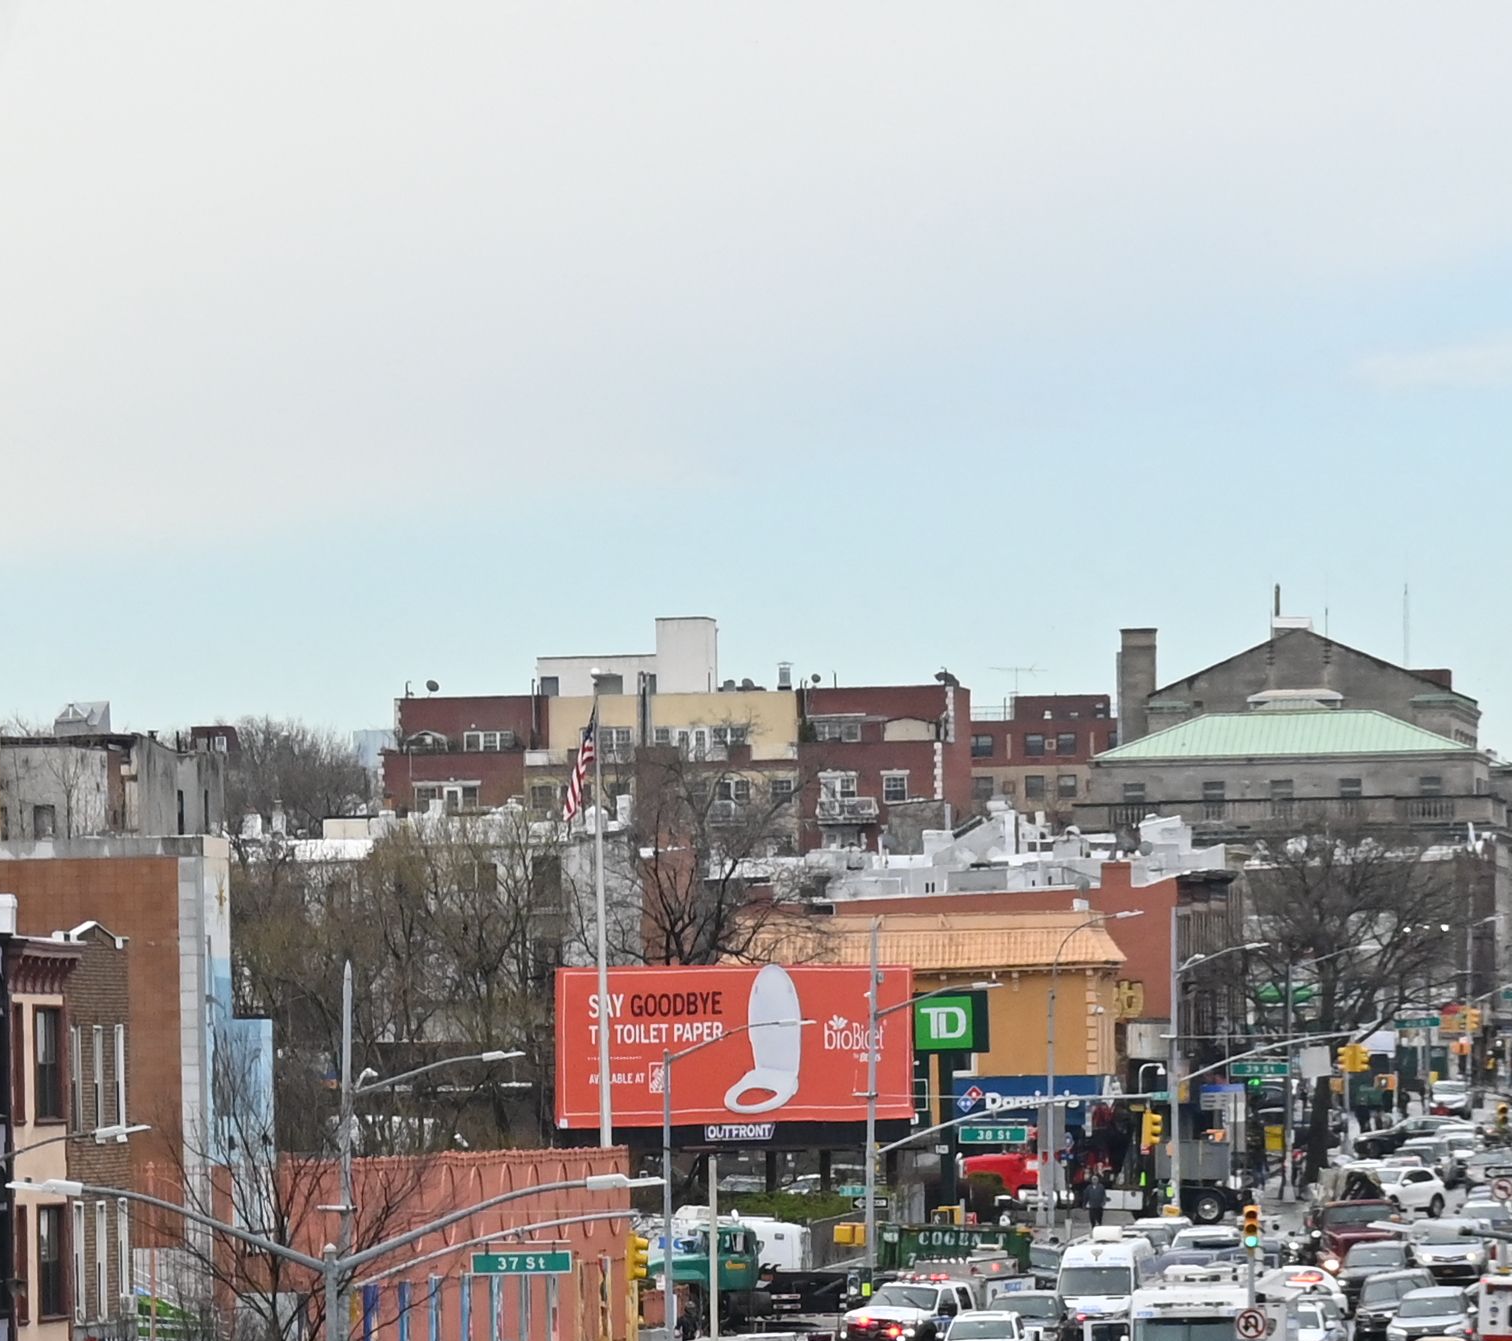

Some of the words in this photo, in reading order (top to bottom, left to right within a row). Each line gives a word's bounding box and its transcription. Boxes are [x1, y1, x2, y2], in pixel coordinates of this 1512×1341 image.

[588, 994, 625, 1018] SAY
[631, 992, 723, 1017] GOODBYE
[920, 1007, 966, 1039] TD
[614, 1024, 668, 1045] TOILET
[634, 1073, 646, 1085] AT
[707, 1124, 773, 1139] OUTFRONT
[997, 1130, 1011, 1141] St
[497, 1257, 519, 1271] 37
[526, 1256, 546, 1270] St
